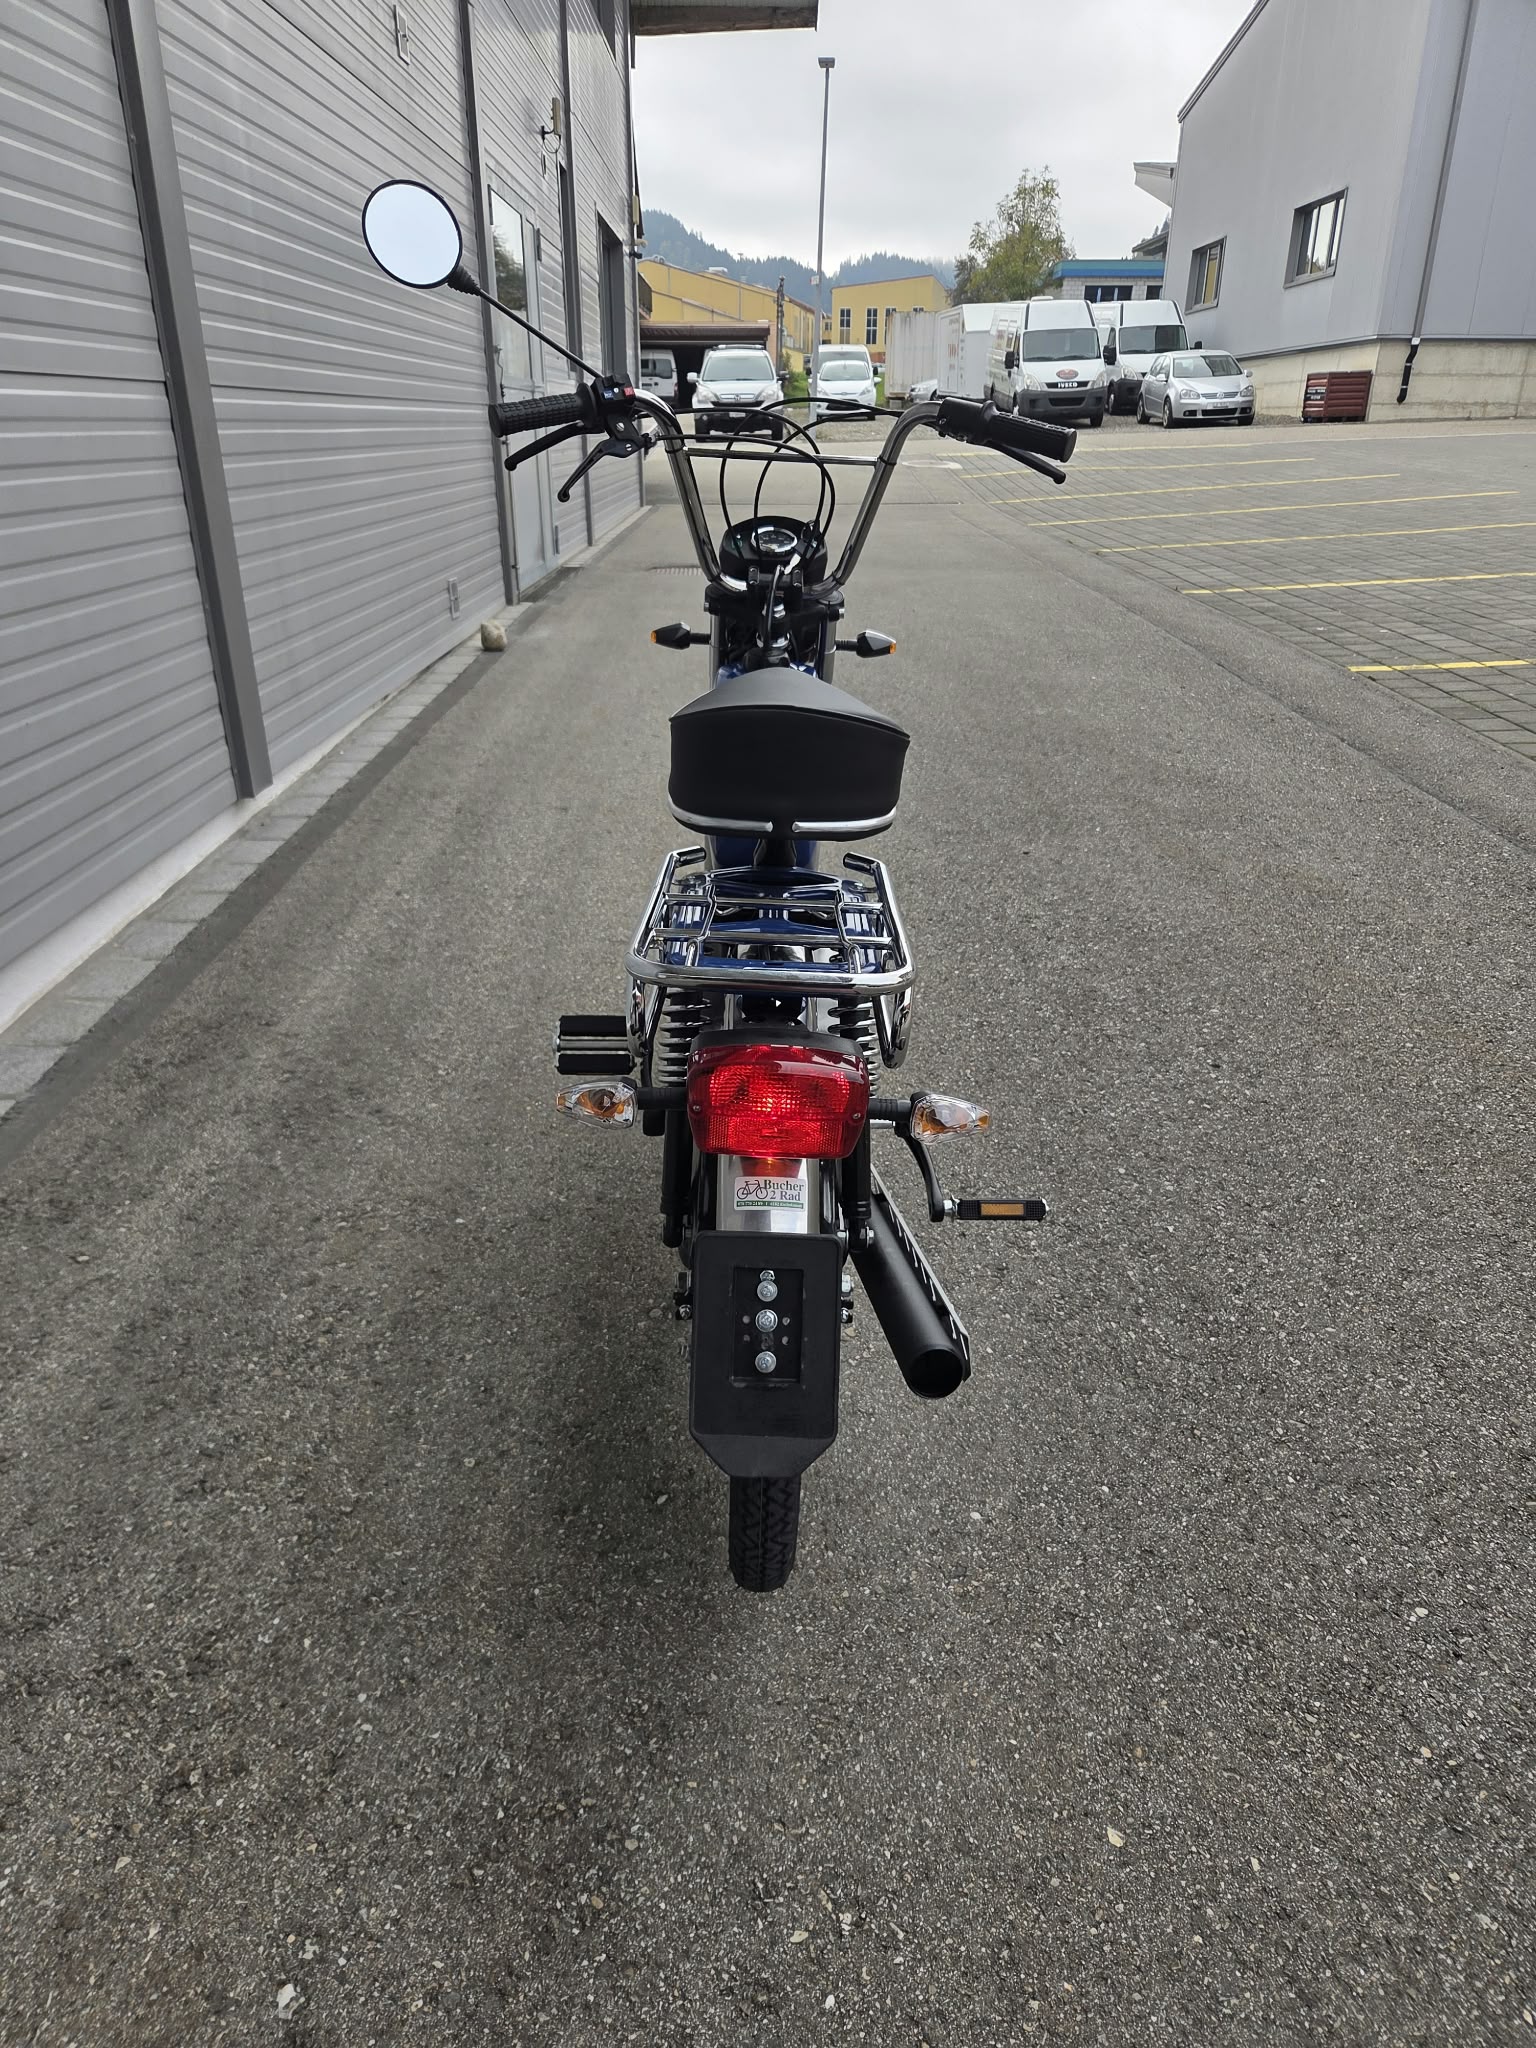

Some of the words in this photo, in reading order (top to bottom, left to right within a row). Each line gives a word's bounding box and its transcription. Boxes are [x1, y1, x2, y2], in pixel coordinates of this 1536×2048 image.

[764, 1179, 804, 1191] Bucher
[770, 1190, 776, 1200] 2
[780, 1190, 801, 1201] Rad
